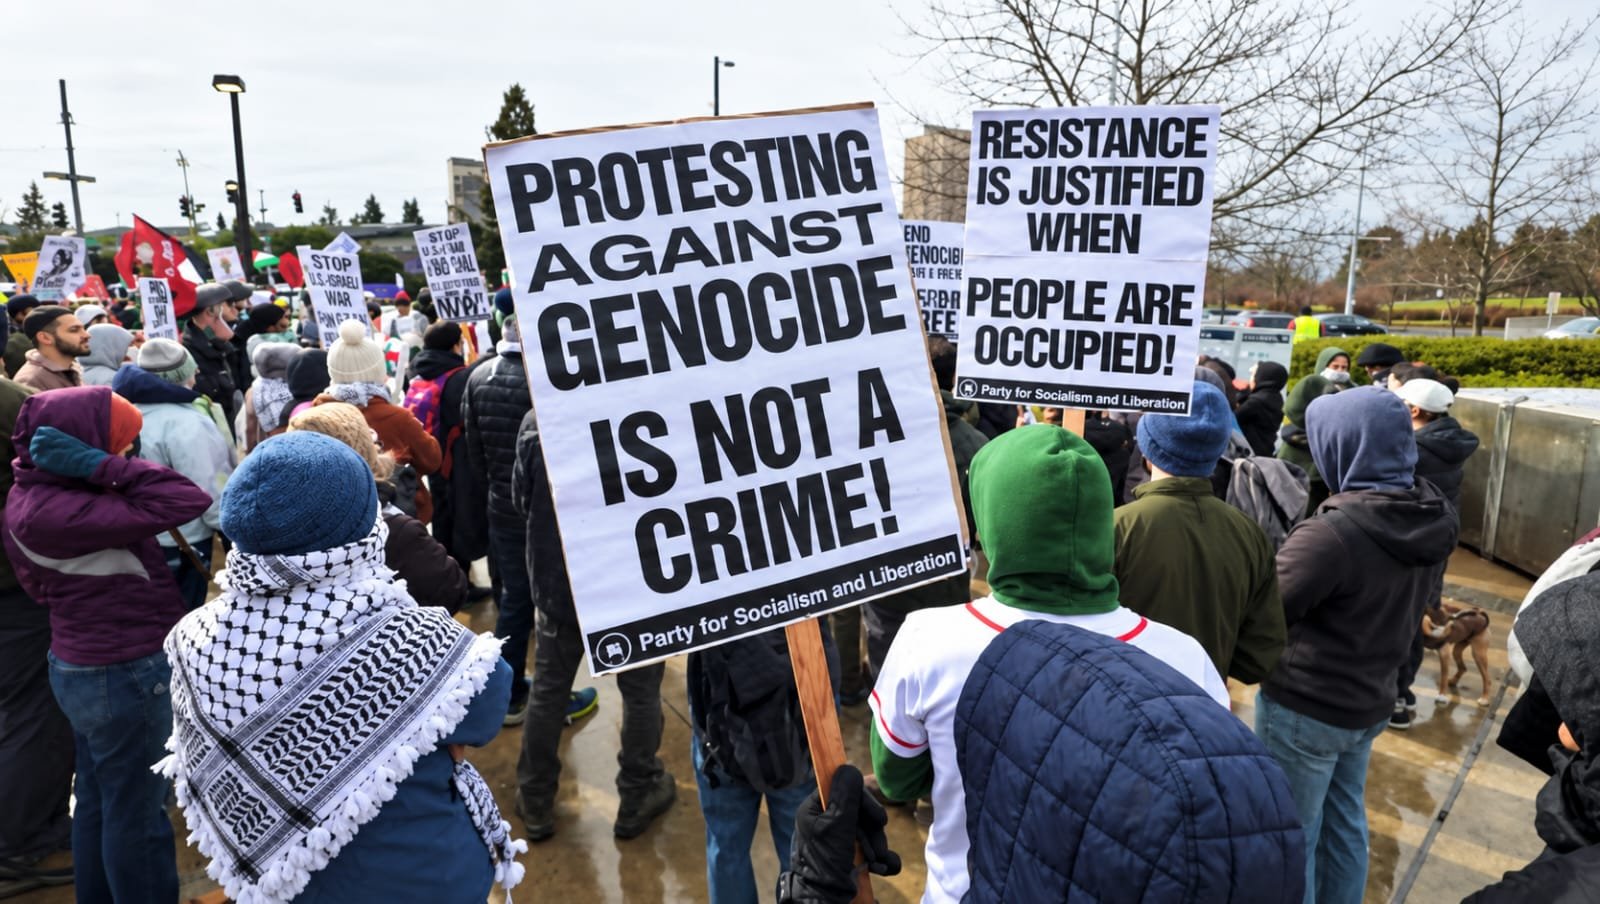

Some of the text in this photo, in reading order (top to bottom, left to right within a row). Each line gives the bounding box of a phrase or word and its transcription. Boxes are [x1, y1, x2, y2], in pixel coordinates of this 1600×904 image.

[979, 117, 1209, 159] RESISTANCE
[505, 130, 877, 233] PROTESTING
[977, 165, 1204, 206] IS JUSTIFIED
[428, 228, 460, 243] STOP
[528, 203, 883, 293] AGAINST
[904, 225, 930, 243] END
[1027, 213, 1141, 254] WHEN
[311, 254, 352, 272] STOP
[325, 290, 352, 307] WAR
[967, 277, 1107, 322] PEOPLE
[1115, 283, 1195, 326] ARE
[538, 255, 906, 391] GENOCIDE
[975, 325, 1176, 376] OCCUPIED!
[981, 385, 1185, 409] Party for Socialism and Liberation
[590, 368, 905, 506] IS NOT A
[635, 458, 899, 594] CRIME!
[639, 552, 957, 651] Party for Socialism and Liberation
